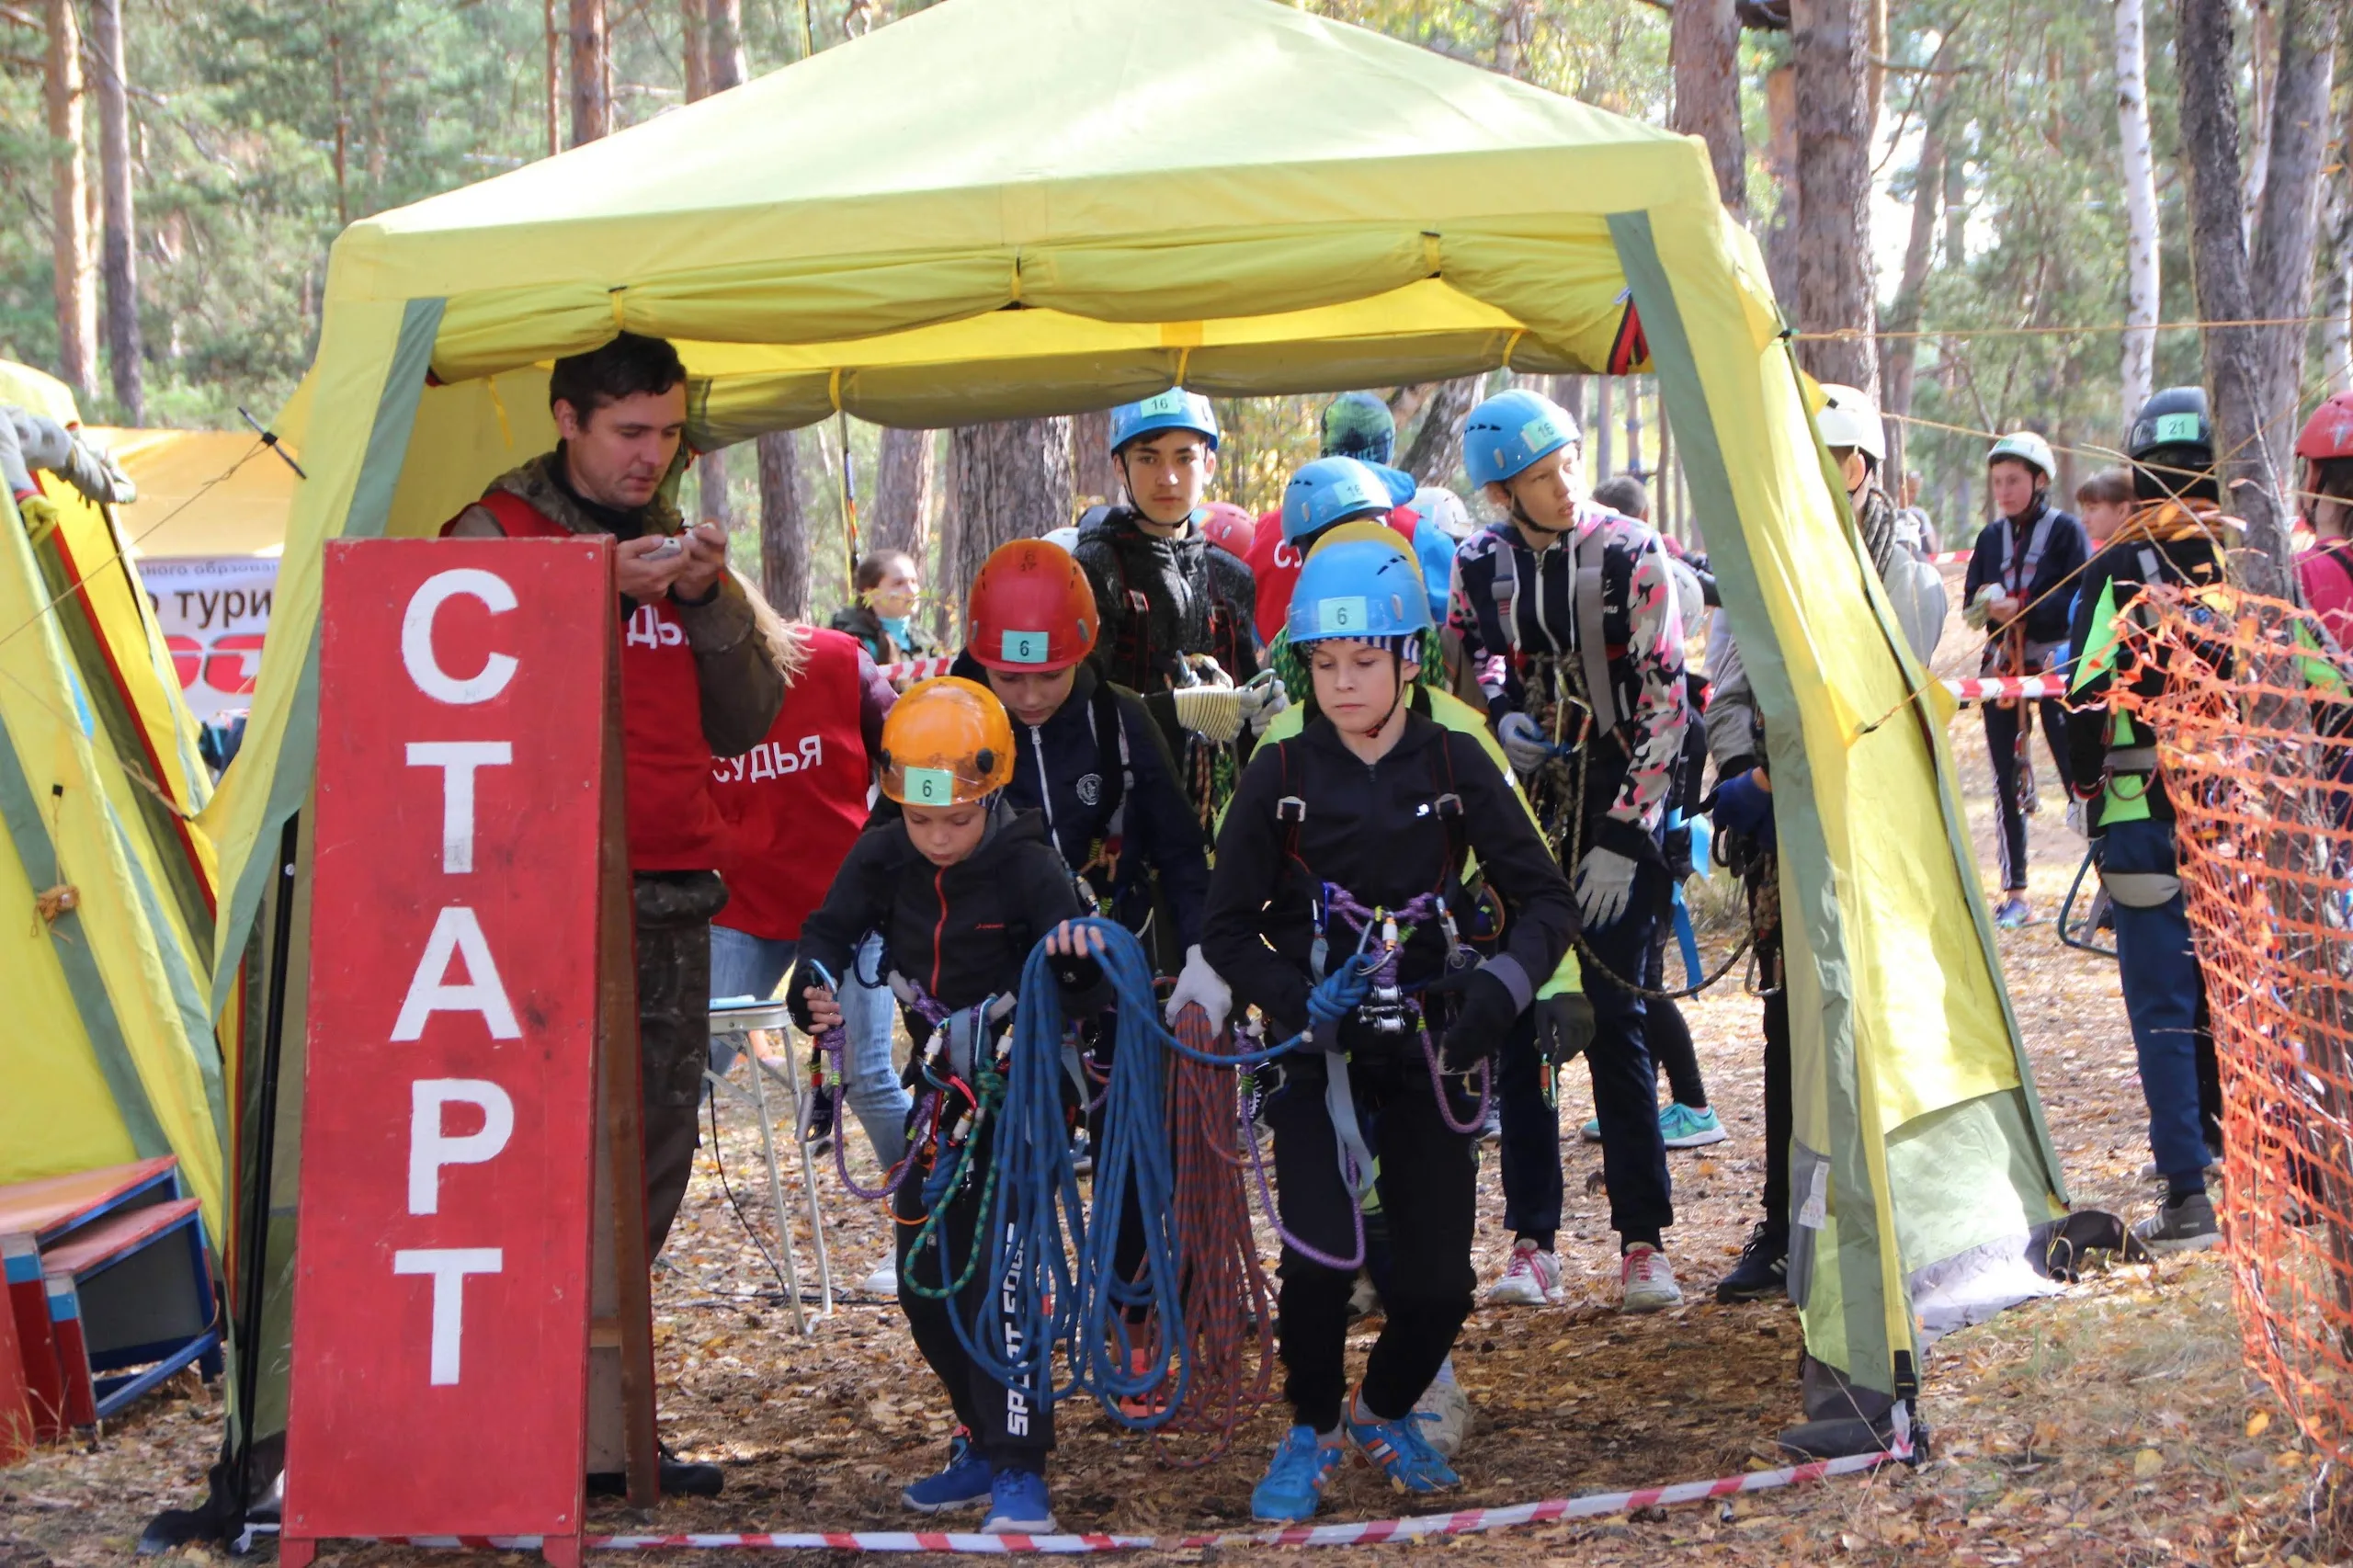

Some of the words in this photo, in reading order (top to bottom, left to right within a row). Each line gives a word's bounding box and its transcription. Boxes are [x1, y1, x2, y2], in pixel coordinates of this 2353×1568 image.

[1151, 398, 1168, 410] 16
[1537, 422, 1554, 437] 16
[2168, 420, 2185, 435] 21
[1336, 607, 1347, 625] 6
[1019, 640, 1029, 657] 6
[922, 779, 933, 798] 6
[390, 567, 521, 1385] СТАРТ
